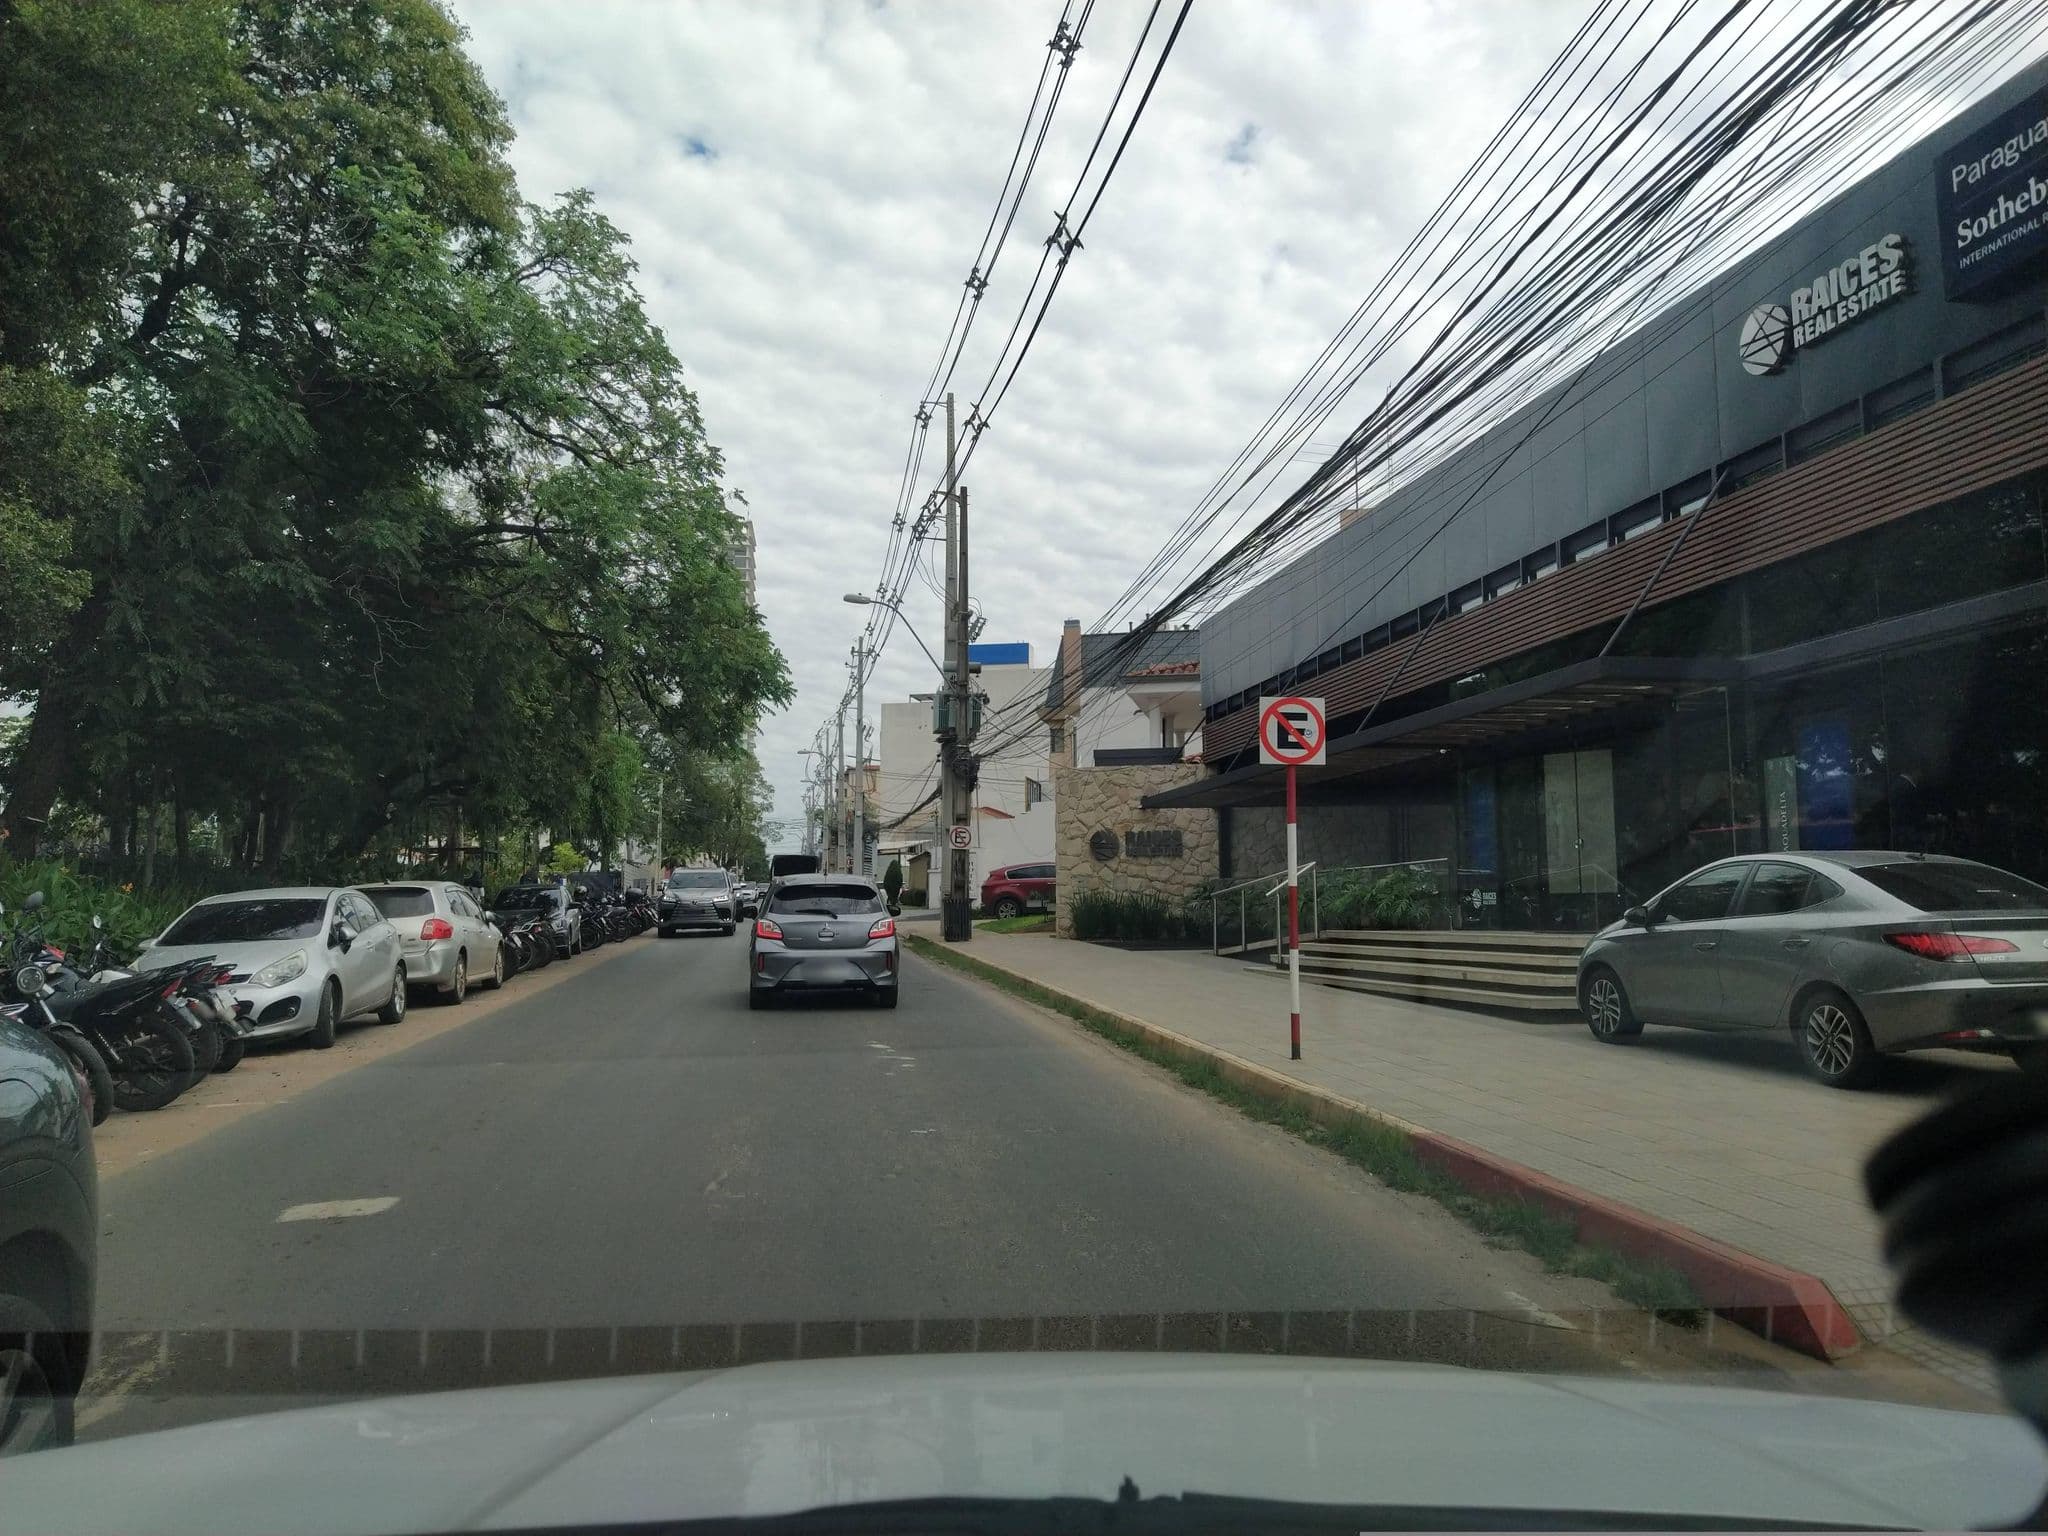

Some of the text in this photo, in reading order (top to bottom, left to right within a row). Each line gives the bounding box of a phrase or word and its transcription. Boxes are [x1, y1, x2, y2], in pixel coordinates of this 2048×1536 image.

[1952, 116, 2048, 193] Paragua
[1957, 176, 2048, 249] Sotheb
[1959, 218, 2041, 270] INTERNATIONAL
[1791, 233, 1903, 326] RAICES
